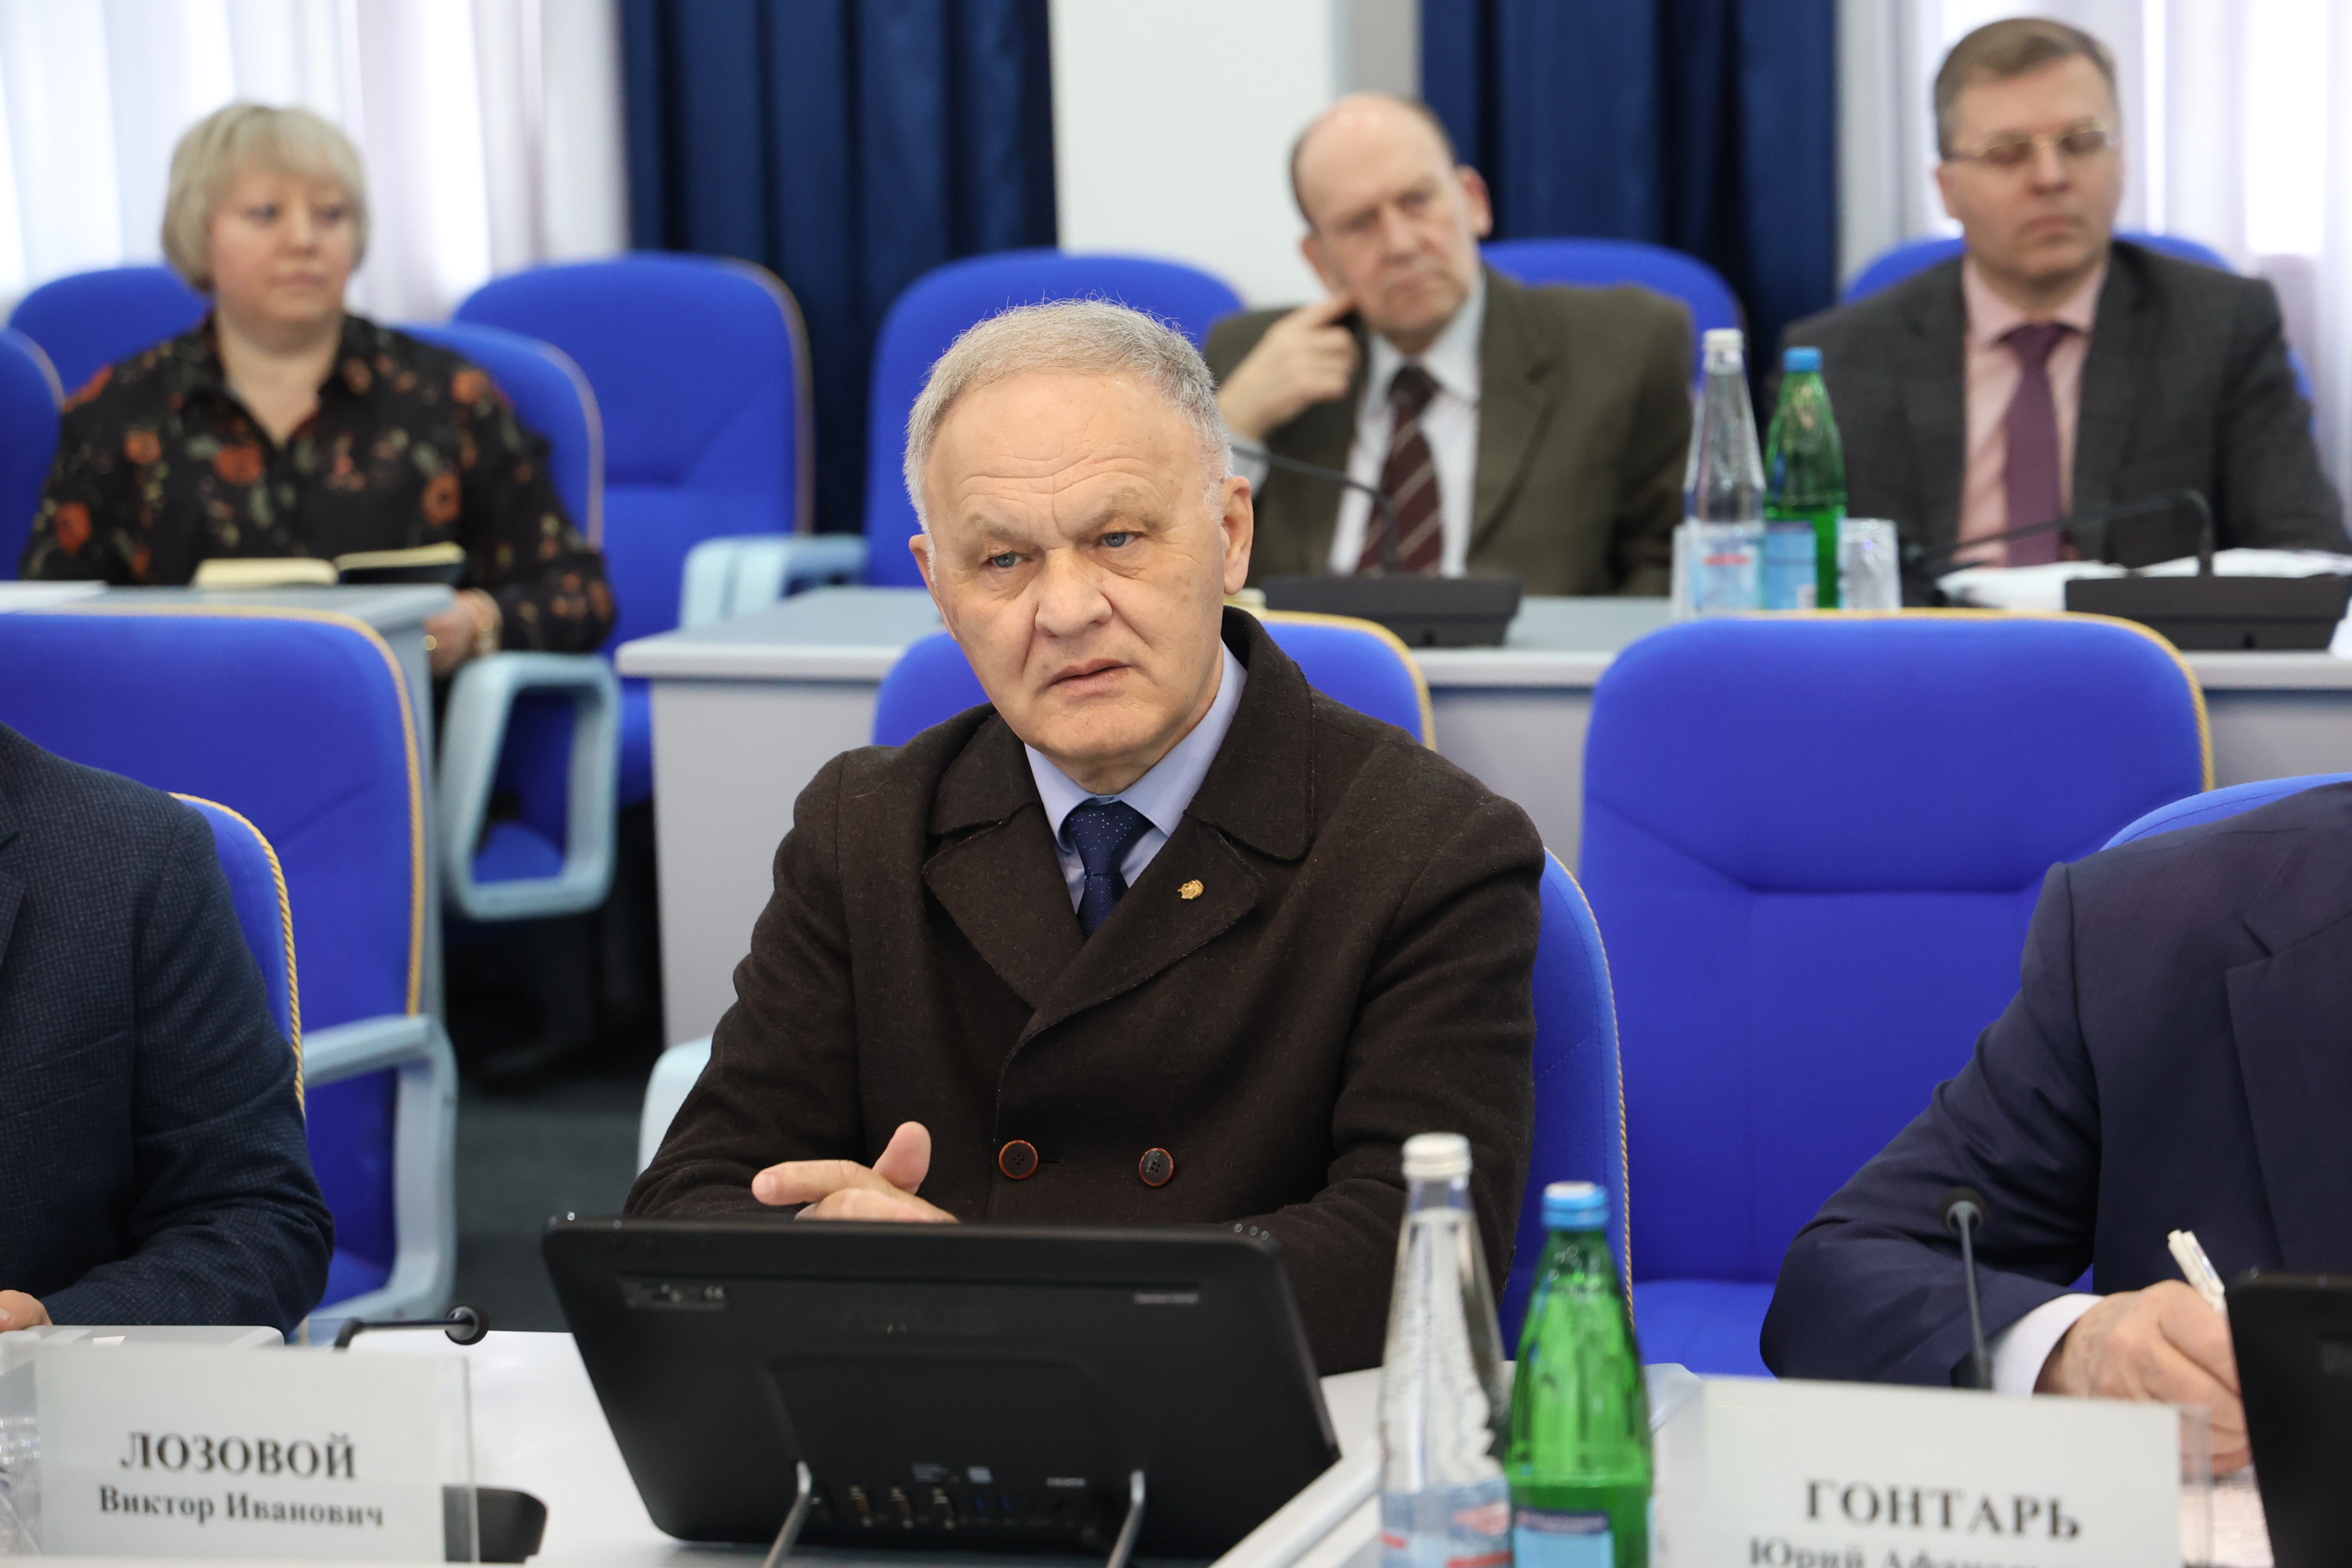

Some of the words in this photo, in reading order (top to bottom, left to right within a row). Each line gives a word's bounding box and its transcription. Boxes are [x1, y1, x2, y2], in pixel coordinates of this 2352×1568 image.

[120, 1431, 355, 1479] ЛОЗОВОЙ
[99, 1484, 215, 1526] Виктор
[227, 1491, 383, 1527] Иванович
[1807, 1480, 2080, 1540] ГОНТАРЬ
[1749, 1535, 1864, 1568] Юрий
